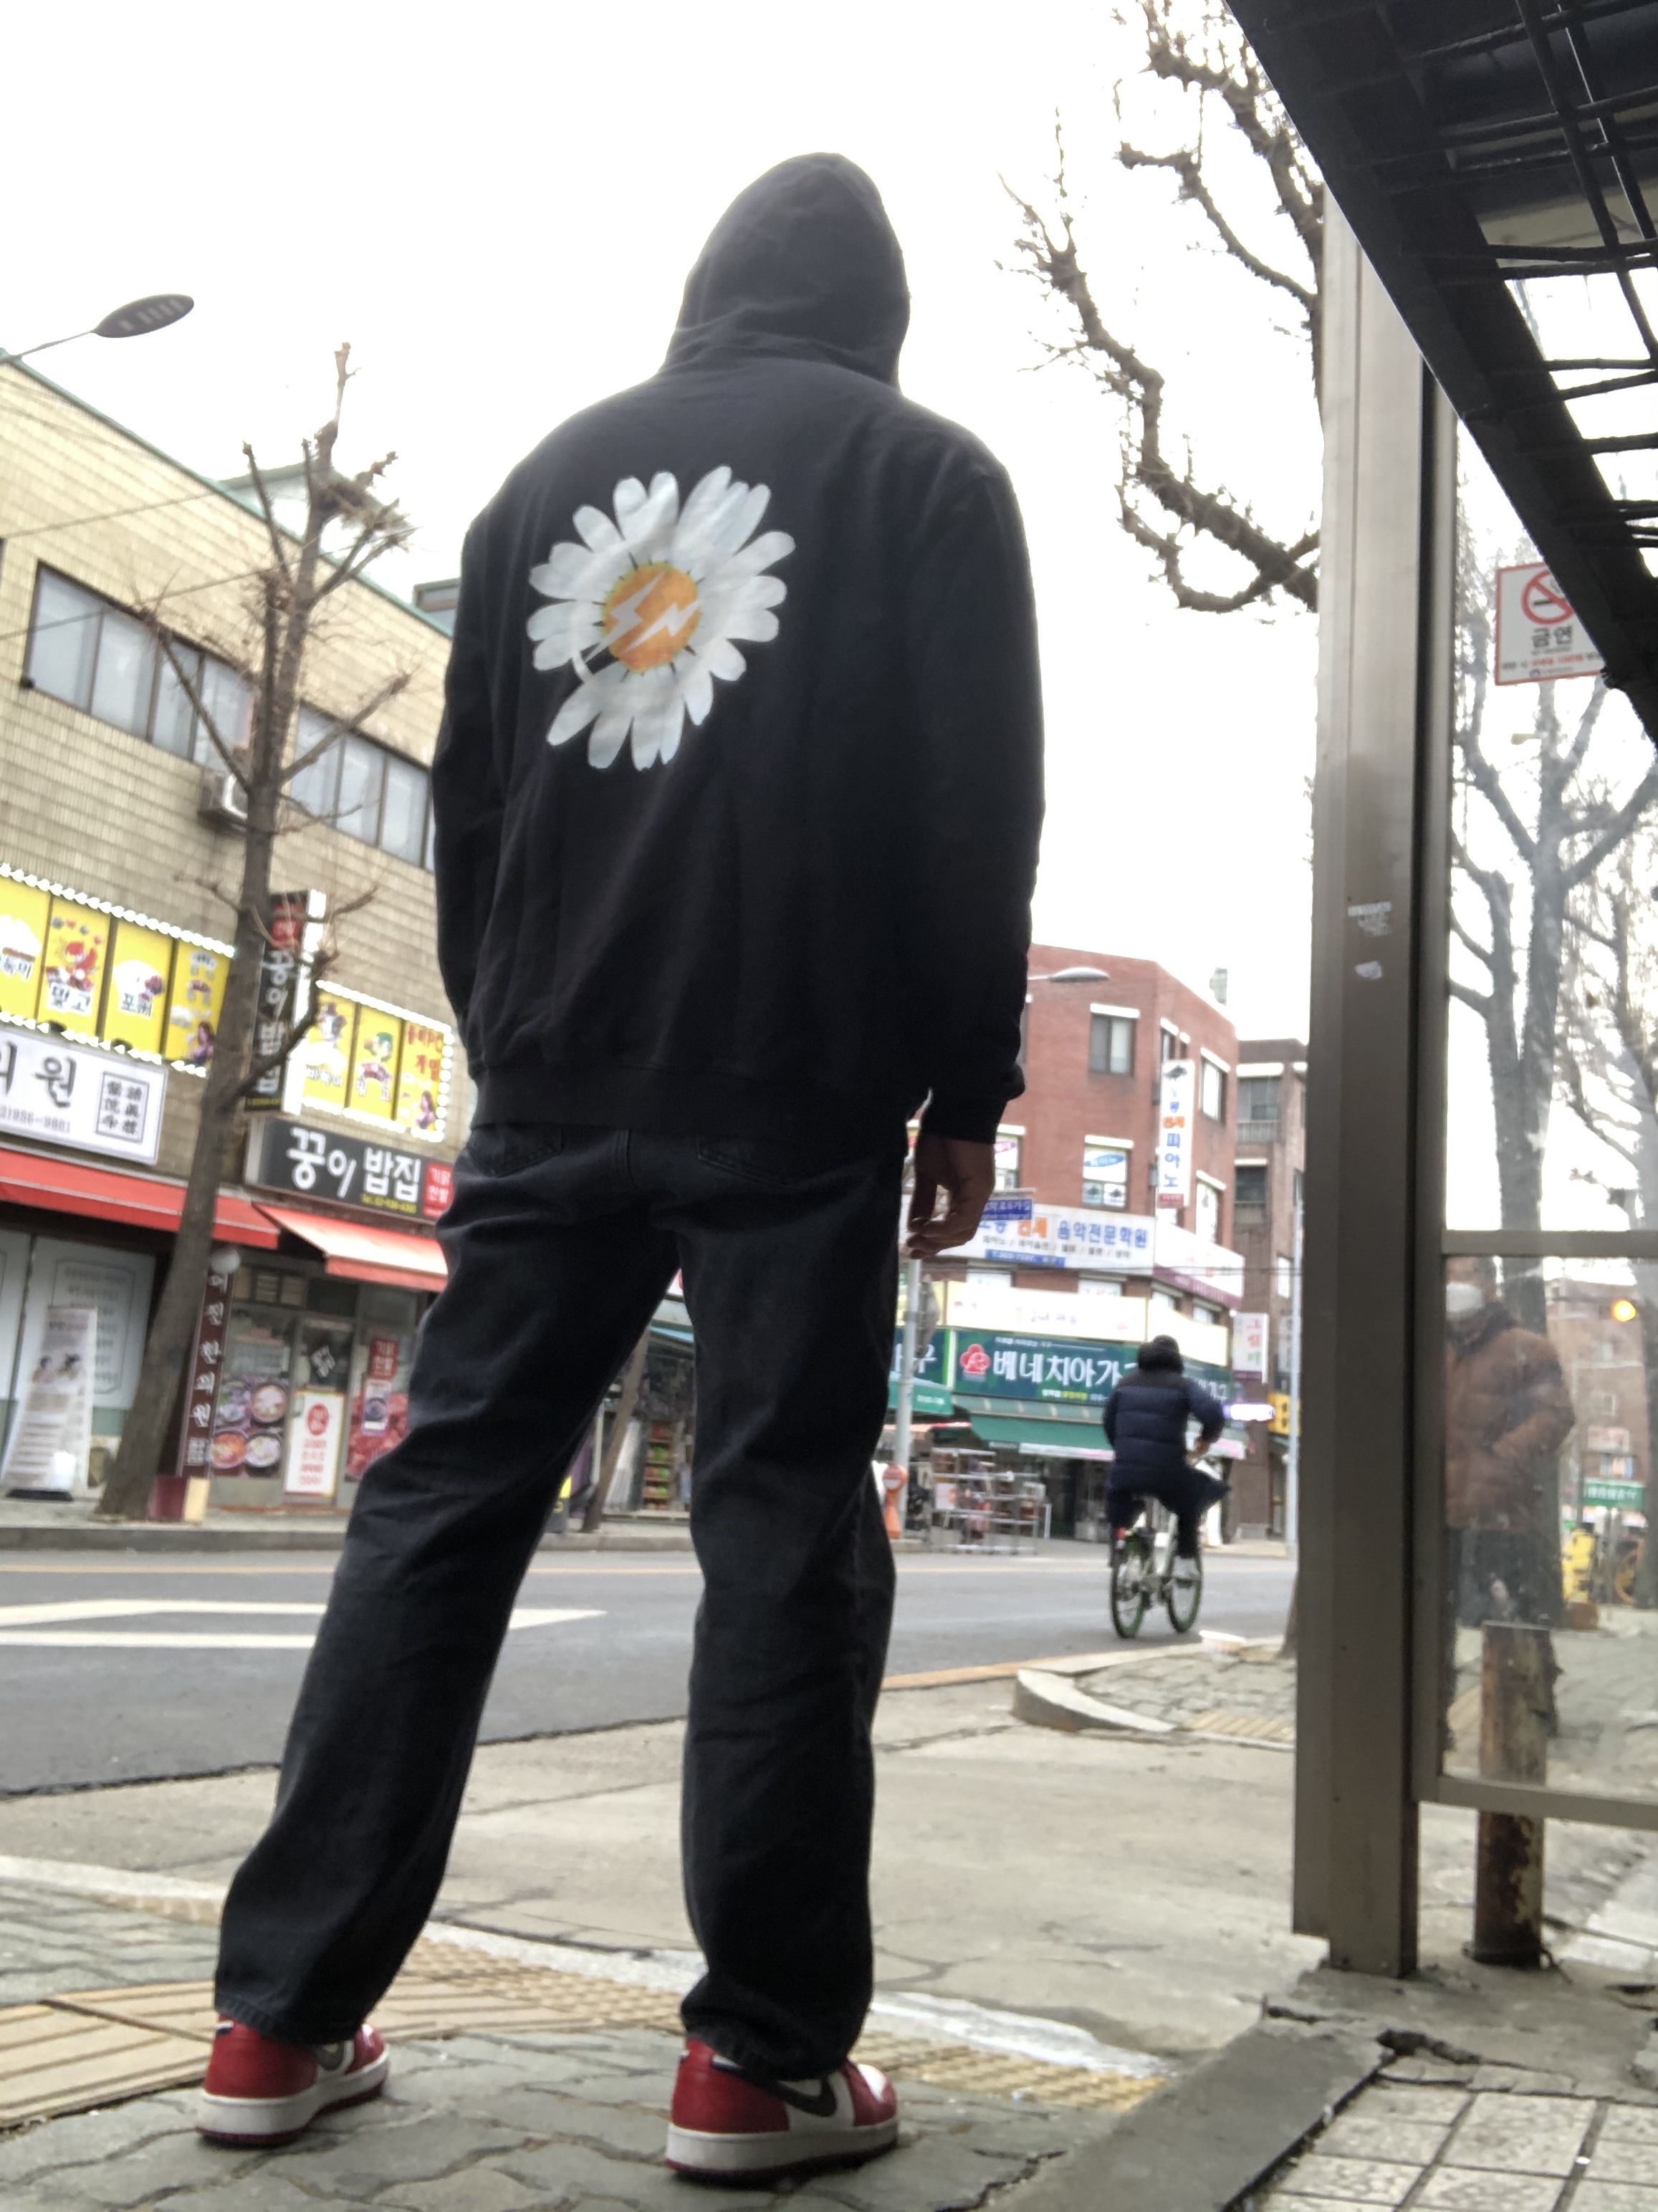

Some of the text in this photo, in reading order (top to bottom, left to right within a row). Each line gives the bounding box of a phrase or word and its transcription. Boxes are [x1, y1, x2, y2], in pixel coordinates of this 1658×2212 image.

[1533, 625, 1573, 648] 금연
[287, 1127, 421, 1203] 꿍이 밥집
[1163, 1133, 1181, 1188] 피아노
[1058, 1220, 1147, 1249] 음악전문학원
[993, 1350, 1138, 1388] 베네치아가
